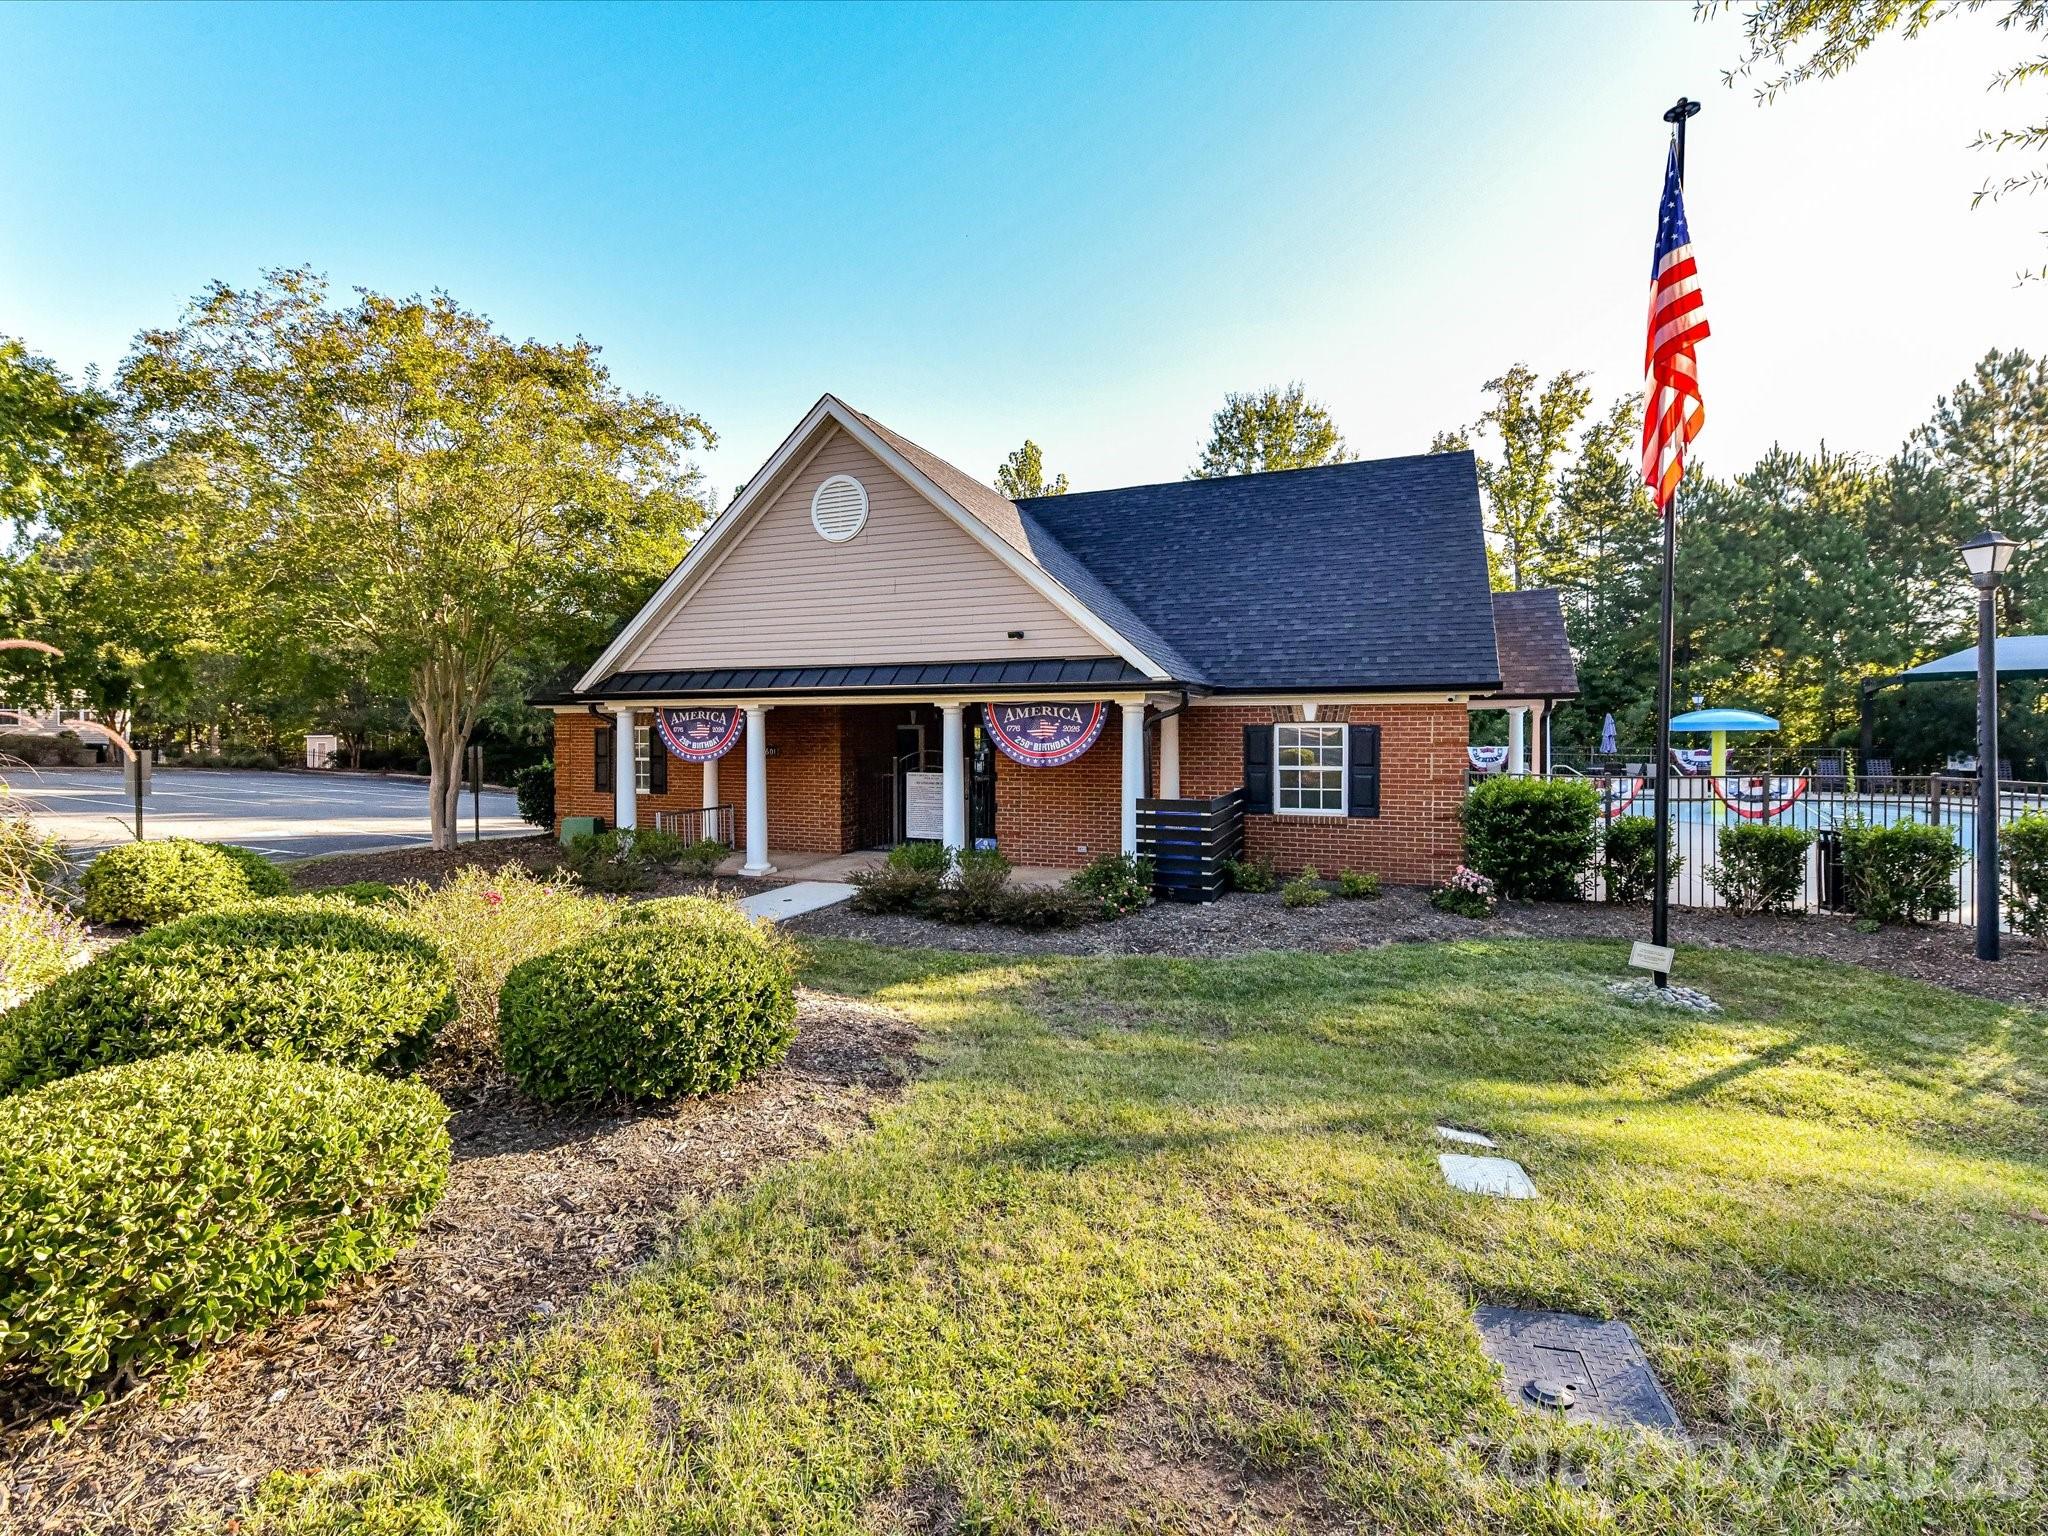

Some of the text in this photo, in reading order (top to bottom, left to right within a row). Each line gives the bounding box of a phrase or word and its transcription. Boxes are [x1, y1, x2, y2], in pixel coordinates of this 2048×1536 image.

[671, 710, 727, 726] AMERICA
[1004, 706, 1083, 723] AMERICA
[1006, 724, 1081, 733] 1776 2026
[1033, 735, 1072, 751] BIRTHDAY
